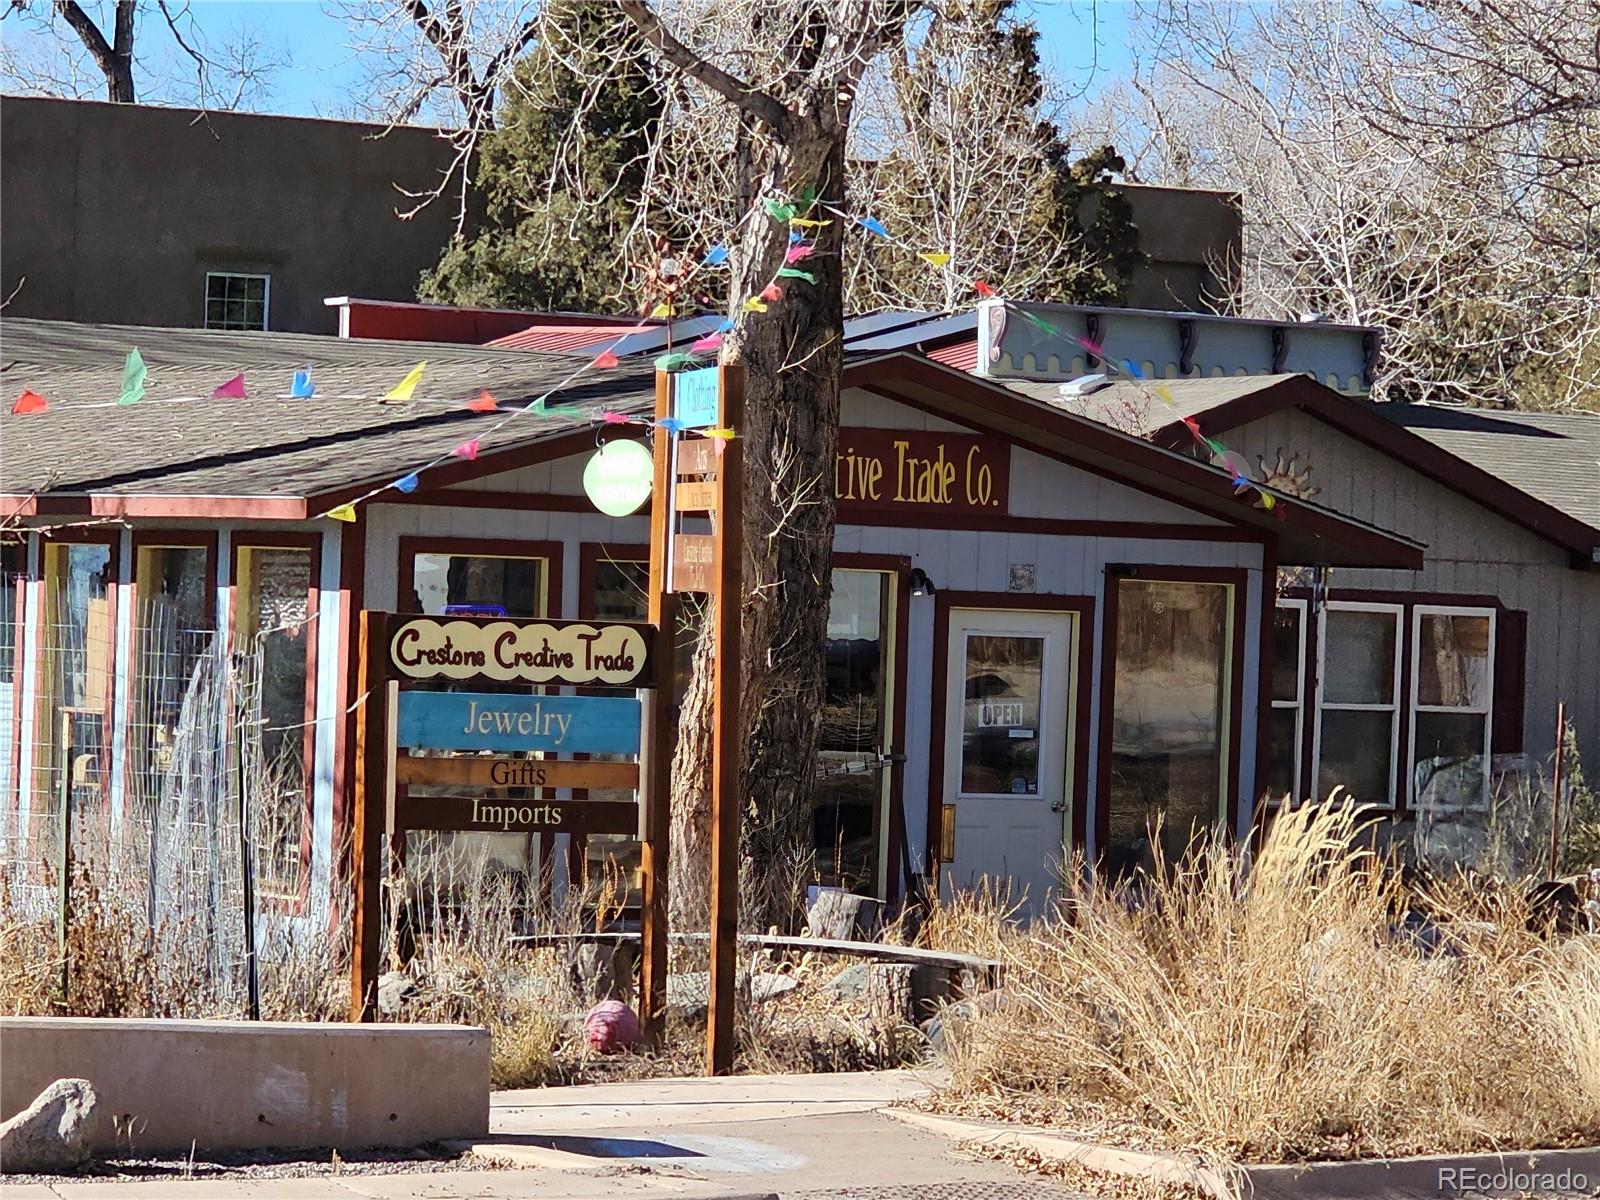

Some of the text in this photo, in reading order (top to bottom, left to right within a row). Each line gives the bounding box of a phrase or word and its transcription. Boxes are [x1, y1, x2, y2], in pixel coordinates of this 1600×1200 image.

[892, 440, 956, 504] Trade
[965, 445, 999, 506] Co.
[396, 628, 635, 672] Crestone Creative Trade
[463, 701, 573, 745] Jewelry
[982, 704, 1021, 726] OPEN
[490, 761, 547, 785] Gifts
[471, 799, 562, 830] Imports
